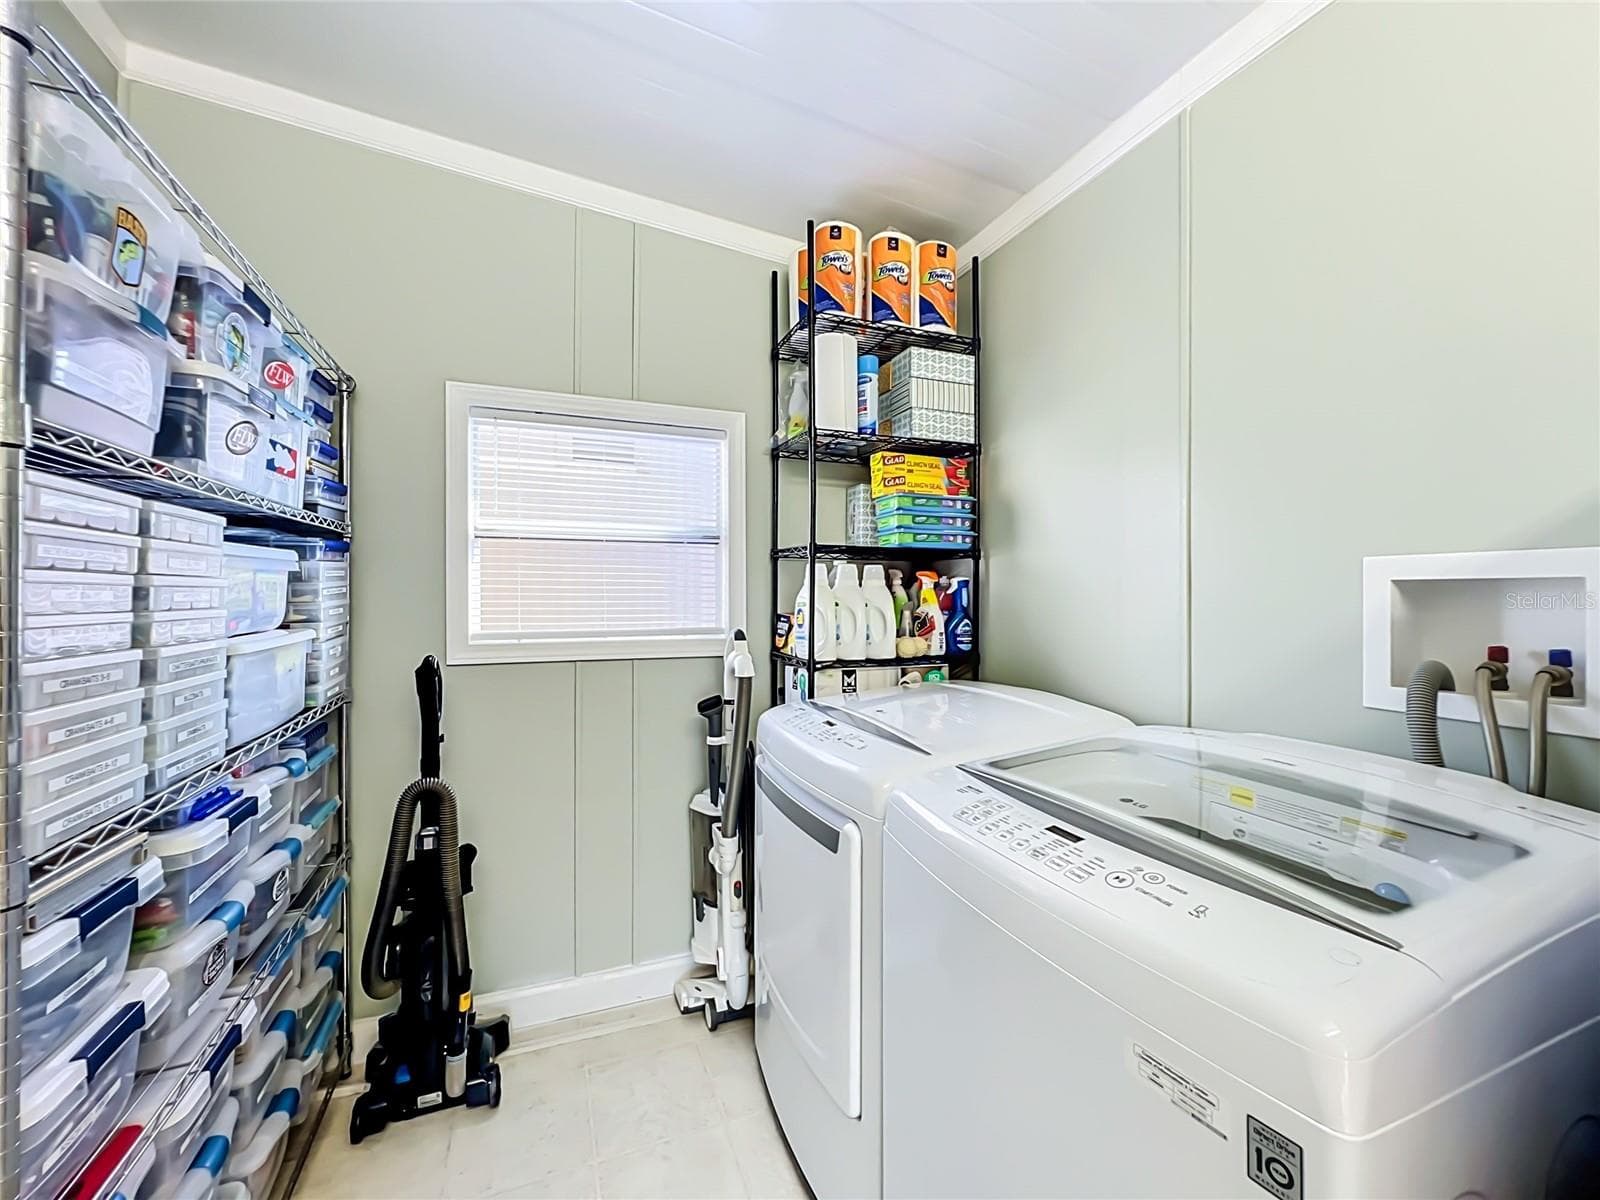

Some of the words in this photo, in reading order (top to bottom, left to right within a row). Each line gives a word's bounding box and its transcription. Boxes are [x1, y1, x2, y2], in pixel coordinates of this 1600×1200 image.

[822, 254, 848, 267] Towels
[878, 265, 905, 277] Towels
[927, 271, 953, 282] Towels
[269, 364, 294, 386] FLW
[232, 428, 257, 448] FLW
[884, 455, 904, 465] GLAD
[928, 462, 942, 470] SEAL
[885, 476, 905, 486] GLAD
[1253, 1127, 1275, 1145] Direct
[1276, 1141, 1295, 1158] Drive
[1255, 1146, 1294, 1190] 10
